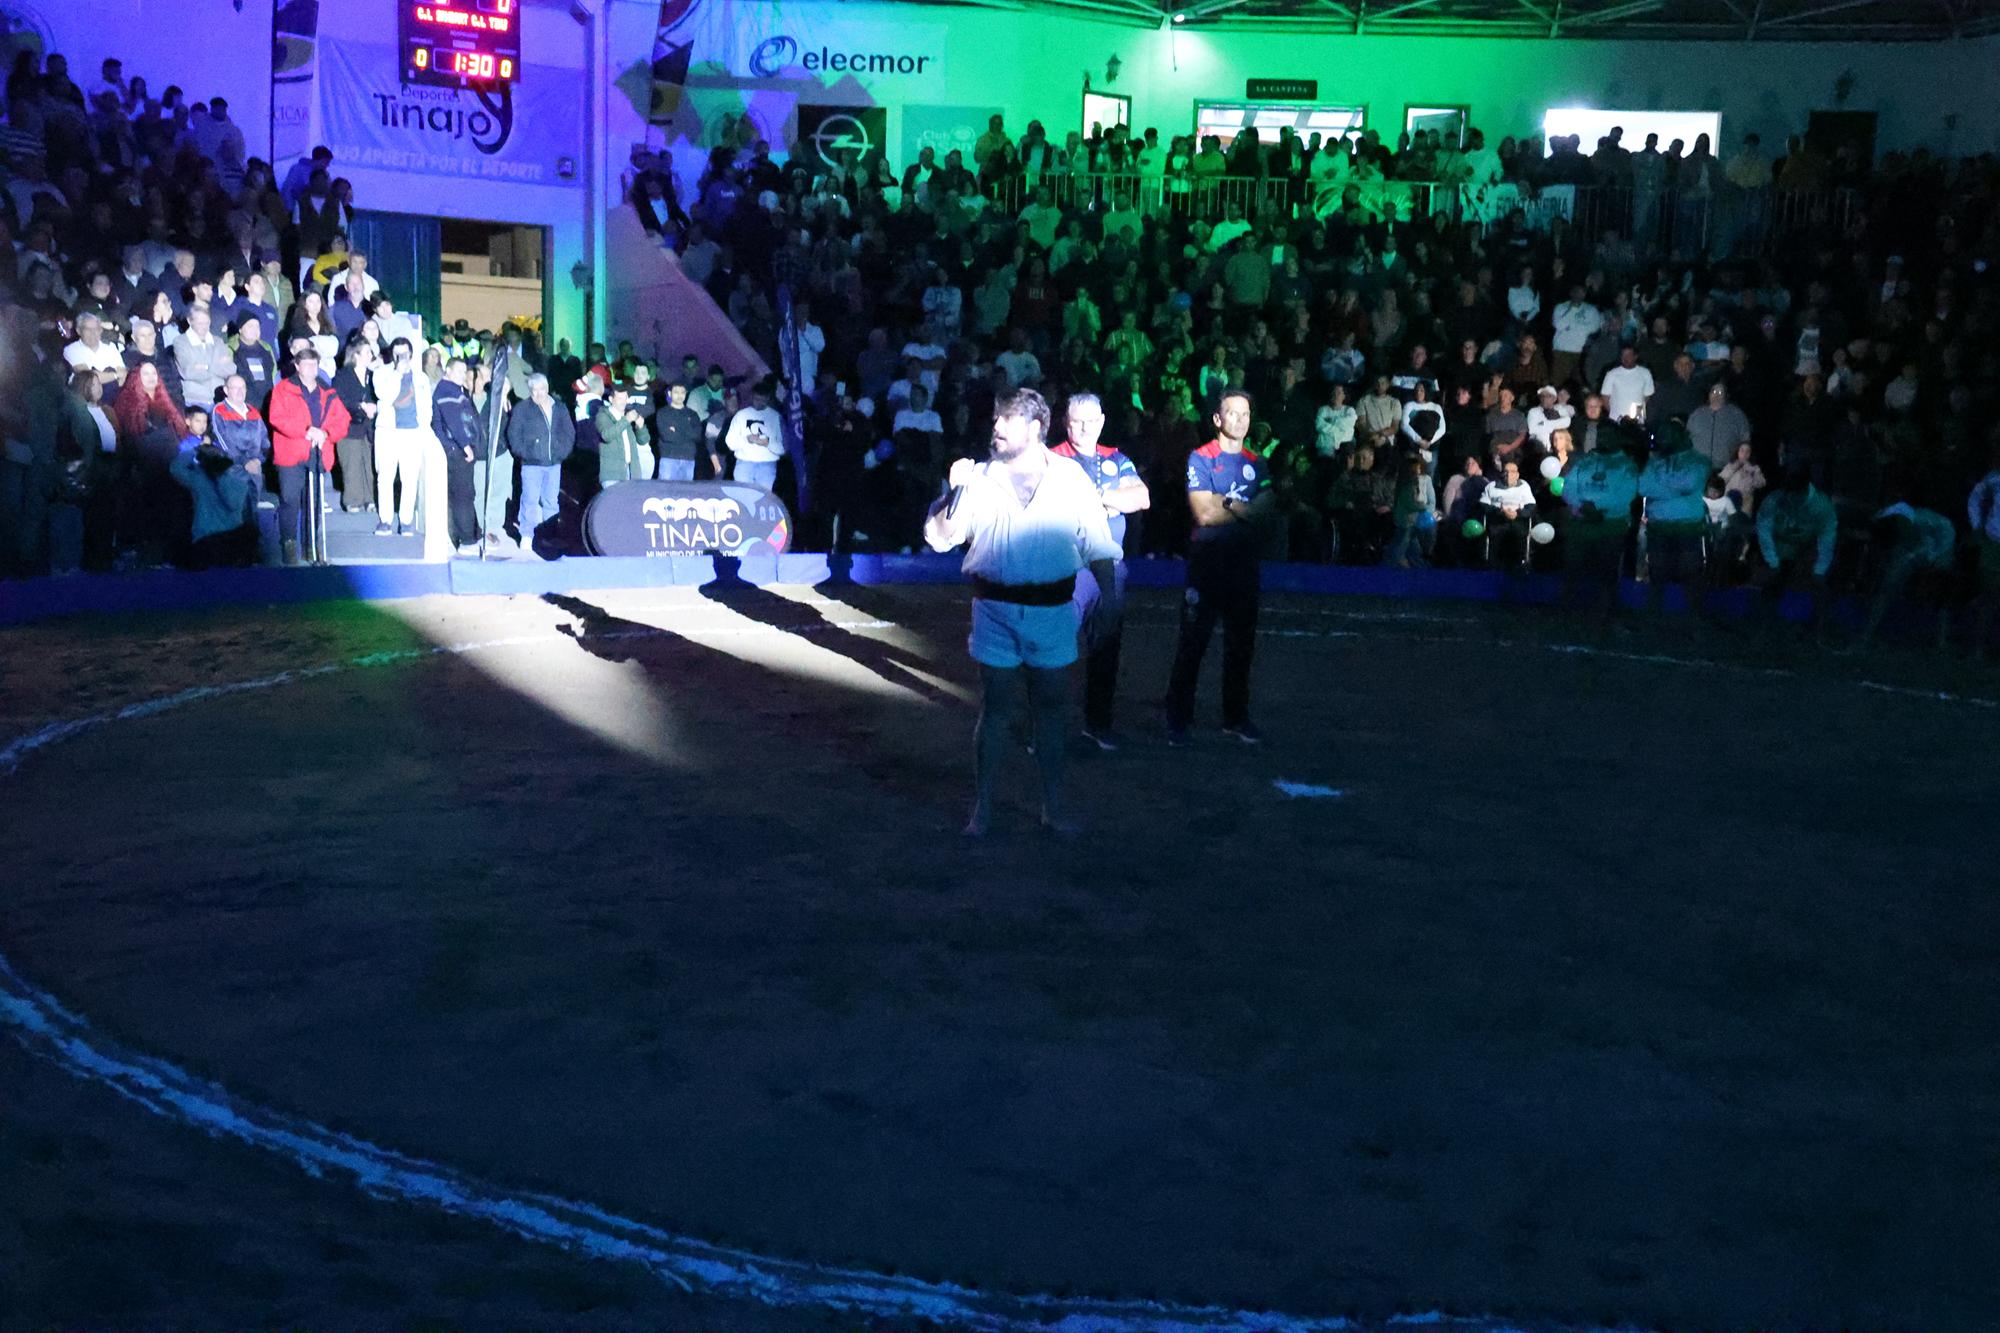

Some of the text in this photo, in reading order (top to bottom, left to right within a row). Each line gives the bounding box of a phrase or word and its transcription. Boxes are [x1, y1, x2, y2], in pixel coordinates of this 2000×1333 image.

[416, 49, 427, 67] 0
[454, 52, 493, 78] 1:30
[500, 59, 512, 78] 0
[802, 46, 930, 74] elecmor
[373, 93, 492, 140] Tinajo
[482, 159, 543, 179] DEPORTE
[643, 523, 743, 548] TINAJO
